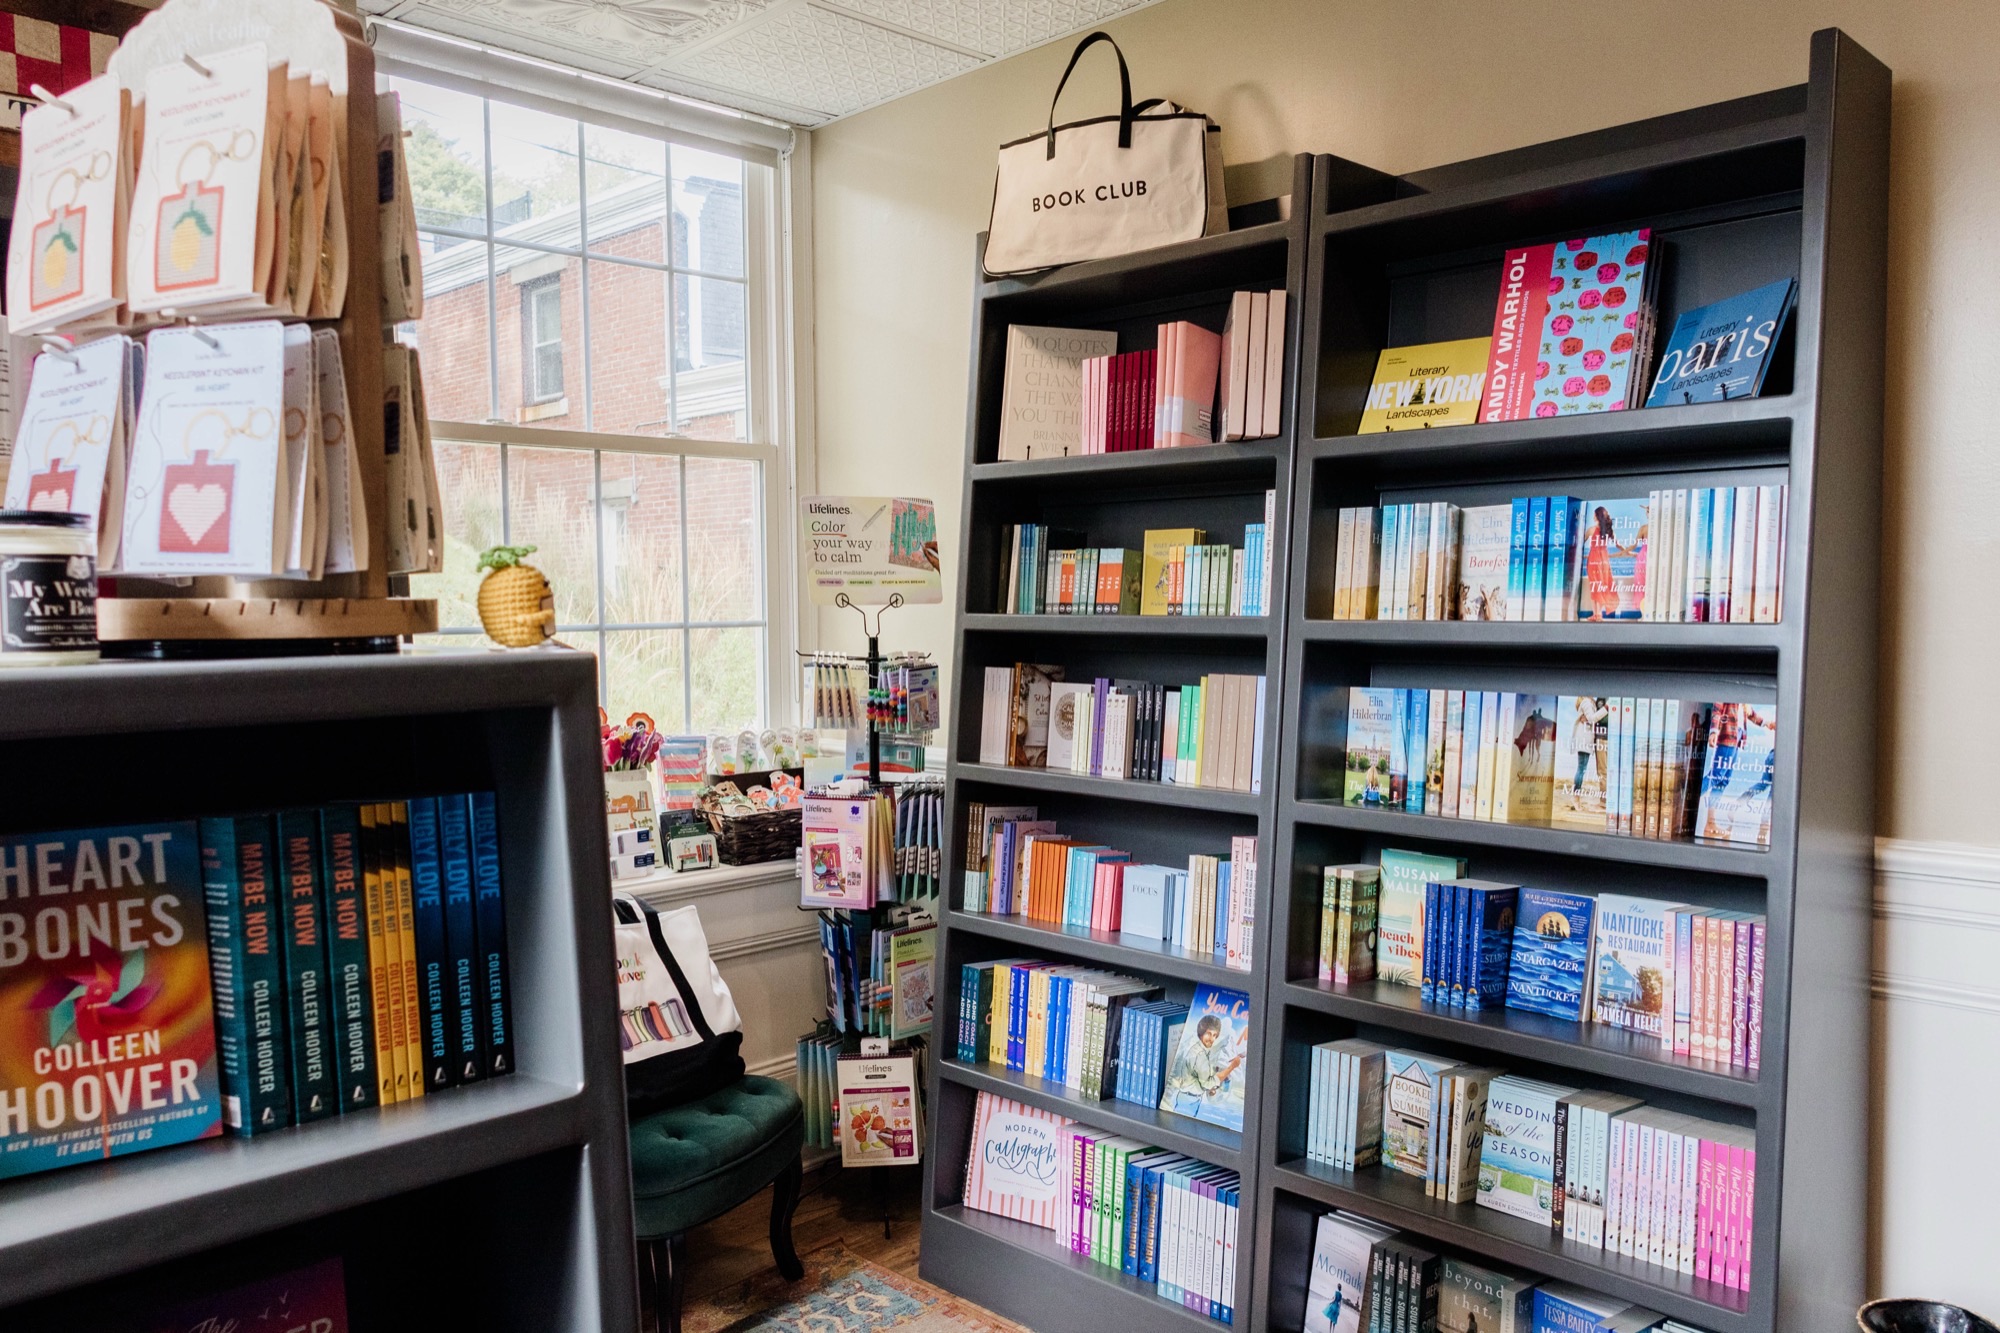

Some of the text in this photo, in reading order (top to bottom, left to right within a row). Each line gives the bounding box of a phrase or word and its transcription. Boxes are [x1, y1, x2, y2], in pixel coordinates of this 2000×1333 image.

[1032, 180, 1148, 213] BOOK CLUB
[1520, 290, 1530, 322] FASHION
[1486, 252, 1528, 422] ANDY WARHOL
[1517, 323, 1525, 336] AND
[1700, 319, 1741, 340] Literary
[1043, 337, 1108, 354] QUOTES
[1512, 337, 1522, 370] TEXTILES
[1021, 352, 1062, 369] THAT
[1648, 315, 1777, 399] paris
[1025, 371, 1082, 388] CHAN
[1409, 364, 1450, 378] Literary
[1670, 365, 1733, 392] Landscapes
[1025, 389, 1082, 408] THE WA
[1364, 371, 1487, 412] NEW YORK
[1506, 371, 1517, 409] COMPLETE
[1013, 407, 1082, 426] YOU THI
[1386, 406, 1450, 421] Landscapes
[1033, 430, 1080, 443] BRIANNA
[811, 520, 846, 533] Color
[1482, 515, 1503, 529] Elin
[1614, 516, 1641, 530] Elin
[812, 538, 872, 551] your way
[1463, 531, 1509, 546] Hilderbra
[1589, 534, 1648, 548] Hilderbra
[814, 551, 862, 563] to calm
[1469, 555, 1508, 569] Barefoo
[9, 580, 47, 598] My
[1590, 580, 1646, 593] The Identic
[1368, 695, 1384, 708] Elin
[1351, 708, 1392, 722] Hilderbran
[1561, 784, 1607, 797] Matchma
[1703, 795, 1742, 812] Winter
[0, 831, 172, 901] HEART
[1393, 865, 1440, 882] SUSAN
[1132, 884, 1158, 897] FOCUS
[1363, 884, 1377, 897] THE
[1383, 879, 1427, 896] MALLE
[1357, 904, 1376, 915] PAPE
[1628, 903, 1646, 914] the
[0, 894, 184, 968] BONES
[413, 810, 445, 1058] UGLY LOVE COLLEEN HOOVER
[1352, 918, 1377, 932] PALAC
[1602, 911, 1664, 940] NANTUCKE
[896, 937, 922, 948] Lifelines
[1379, 927, 1415, 945] beach
[1388, 944, 1422, 960] vibes
[1543, 942, 1558, 951] THE
[1608, 935, 1663, 957] RESTAURANT
[241, 843, 275, 1094] MAYBE NOW COLLEEN HOOVER
[290, 836, 323, 1082] MAYBE NOW COLLEEN HOOVER
[1515, 952, 1579, 973] STARGAZER
[1539, 973, 1549, 981] OF
[1510, 981, 1578, 1003] NANTUCKET
[1202, 992, 1249, 1020] You Ca
[1597, 1004, 1631, 1027] PAMELA
[33, 1029, 161, 1075] COLLEEN
[858, 1064, 892, 1073] Lifelines
[0, 1057, 201, 1138] HOOVER
[7, 1105, 209, 1152] NEW YORK TIMES BESTSELLING AUTHOR OF
[1005, 1124, 1046, 1140] MODERN
[1505, 1121, 1544, 1142] of the
[56, 1127, 153, 1157] IT ENDS WITH US
[1555, 1108, 1565, 1177] The Summer Club
[1491, 1139, 1551, 1166] SEASON
[1483, 1196, 1546, 1222] LAUREN EDMONDSON
[1315, 1253, 1362, 1293] Montauk
[1444, 1263, 1504, 1299] beyond
[1370, 1291, 1380, 1328] SOULMATE
[1382, 1296, 1392, 1333] SOULMATE
[1453, 1293, 1492, 1321] that,
[1543, 1303, 1567, 1325] TESSA
[1567, 1311, 1597, 1333] BAILEY
